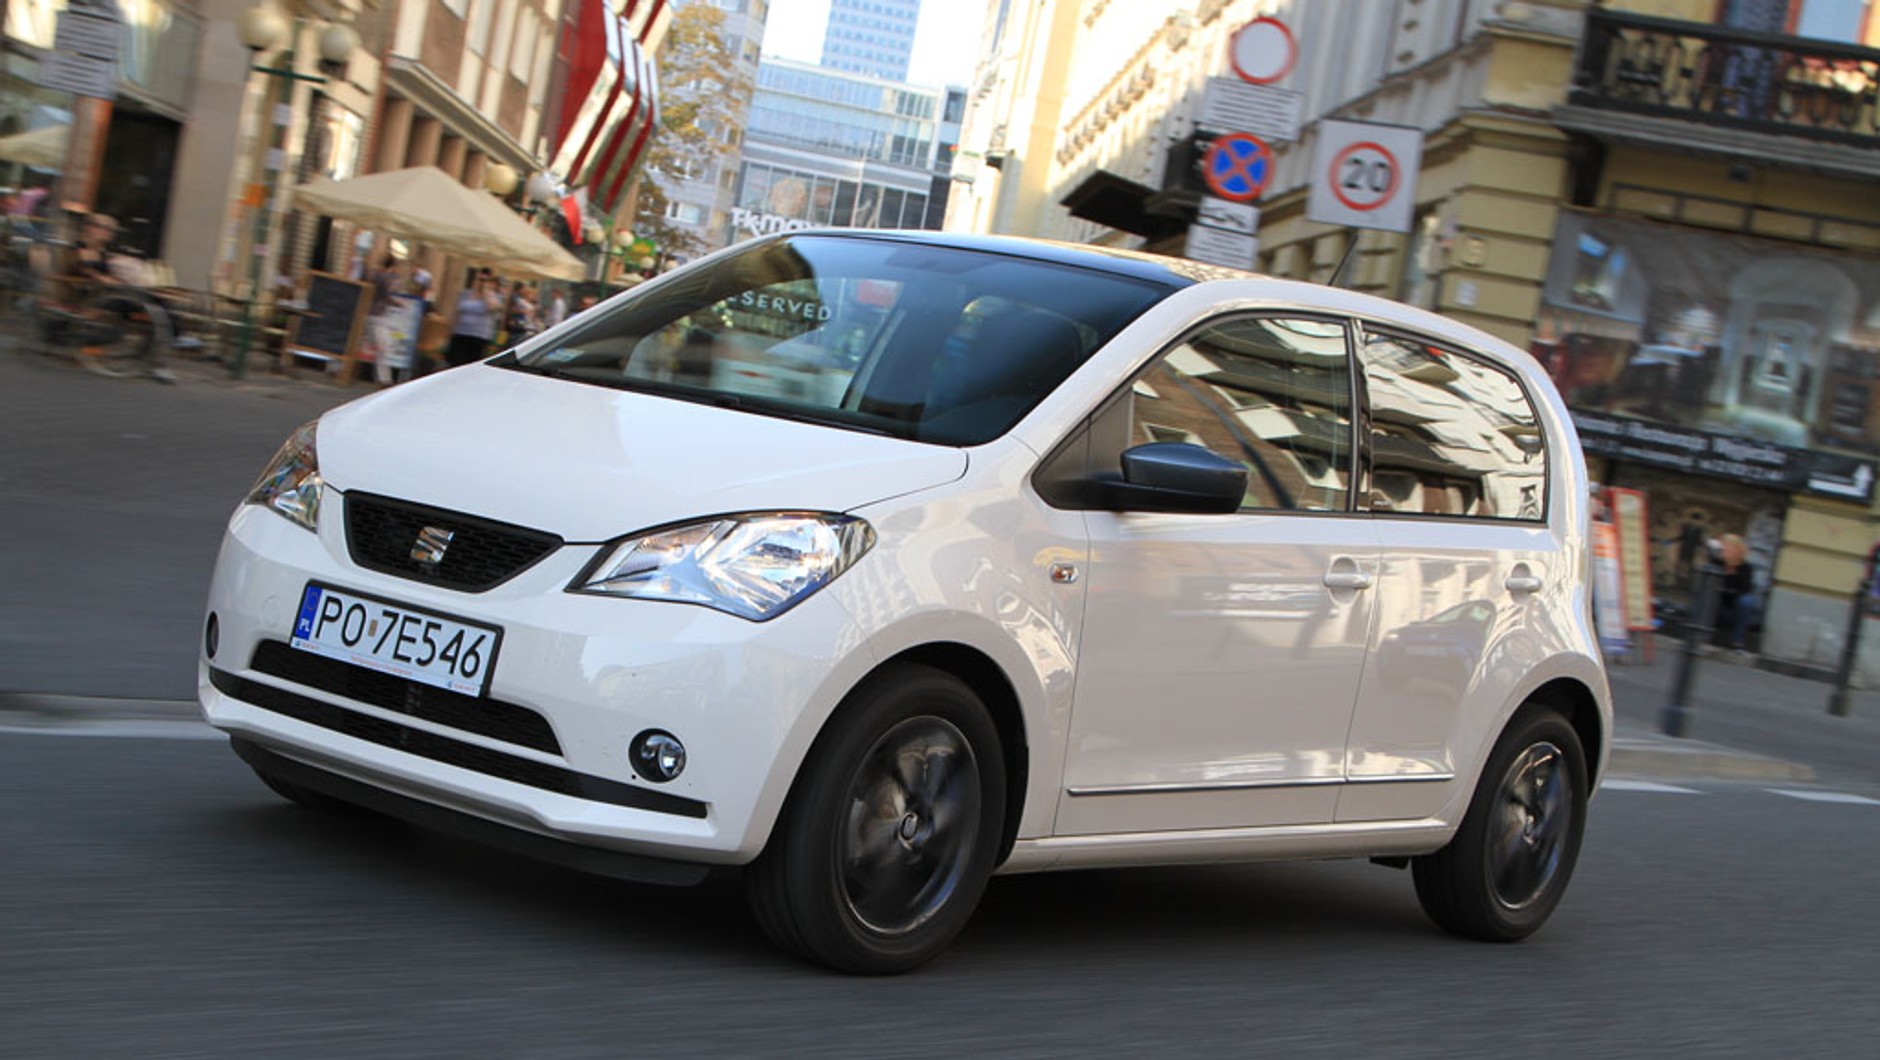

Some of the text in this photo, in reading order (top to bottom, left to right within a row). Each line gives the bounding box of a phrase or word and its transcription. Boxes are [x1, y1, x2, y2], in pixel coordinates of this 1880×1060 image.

[1344, 157, 1391, 192] 20
[727, 290, 832, 321] SERVED
[299, 618, 311, 633] PL
[315, 596, 487, 679] PO 7E546
